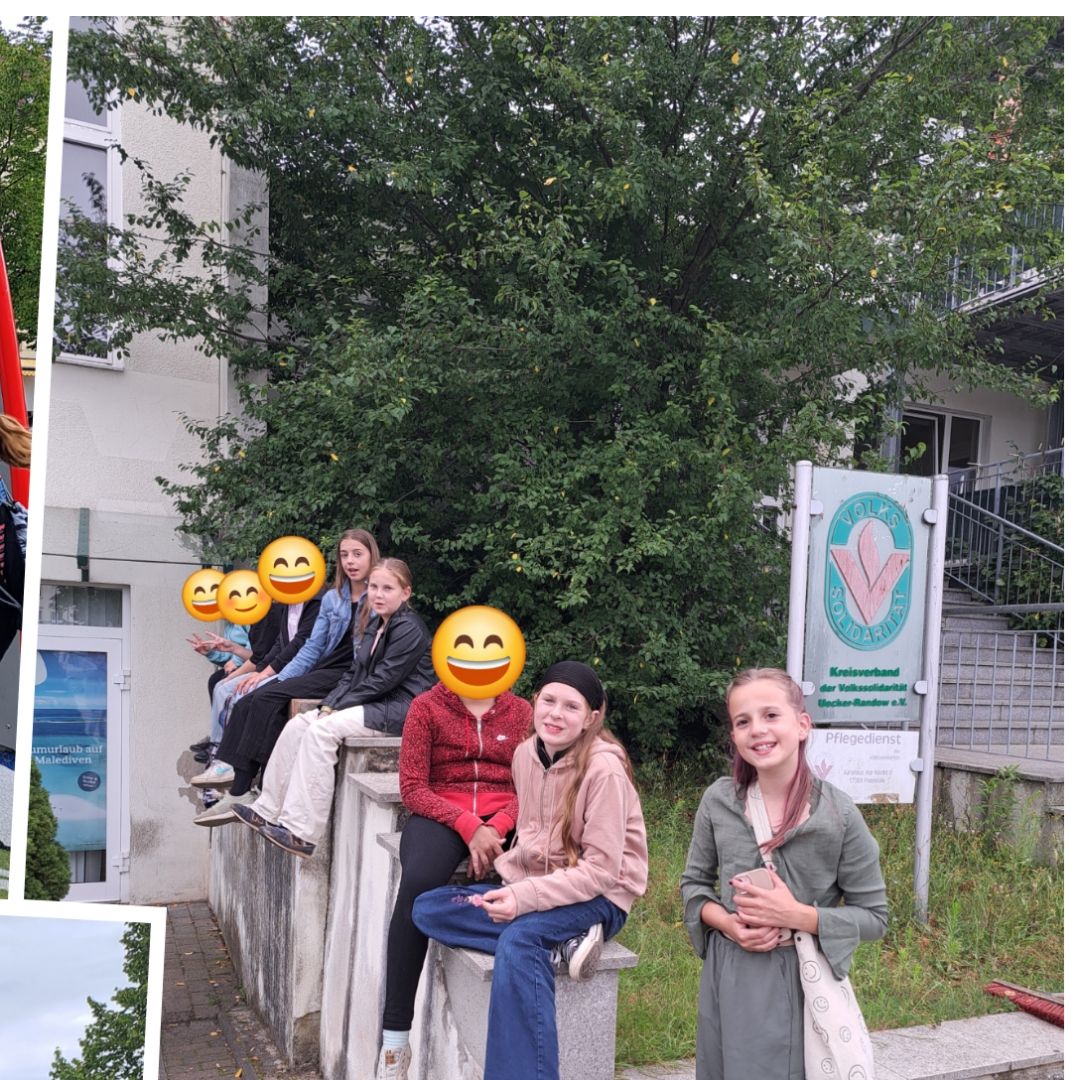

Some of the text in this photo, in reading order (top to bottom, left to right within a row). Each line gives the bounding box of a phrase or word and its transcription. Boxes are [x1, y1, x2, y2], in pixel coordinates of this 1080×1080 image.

[842, 500, 901, 529] VOLKS
[829, 666, 900, 677] Kreisverband
[820, 683, 908, 692] der Volkssolidarität
[818, 698, 908, 707] Uecker-Randow e.V.
[825, 732, 901, 746] Pflegedienst
[85, 745, 103, 754] auf
[35, 755, 92, 764] Malediven
